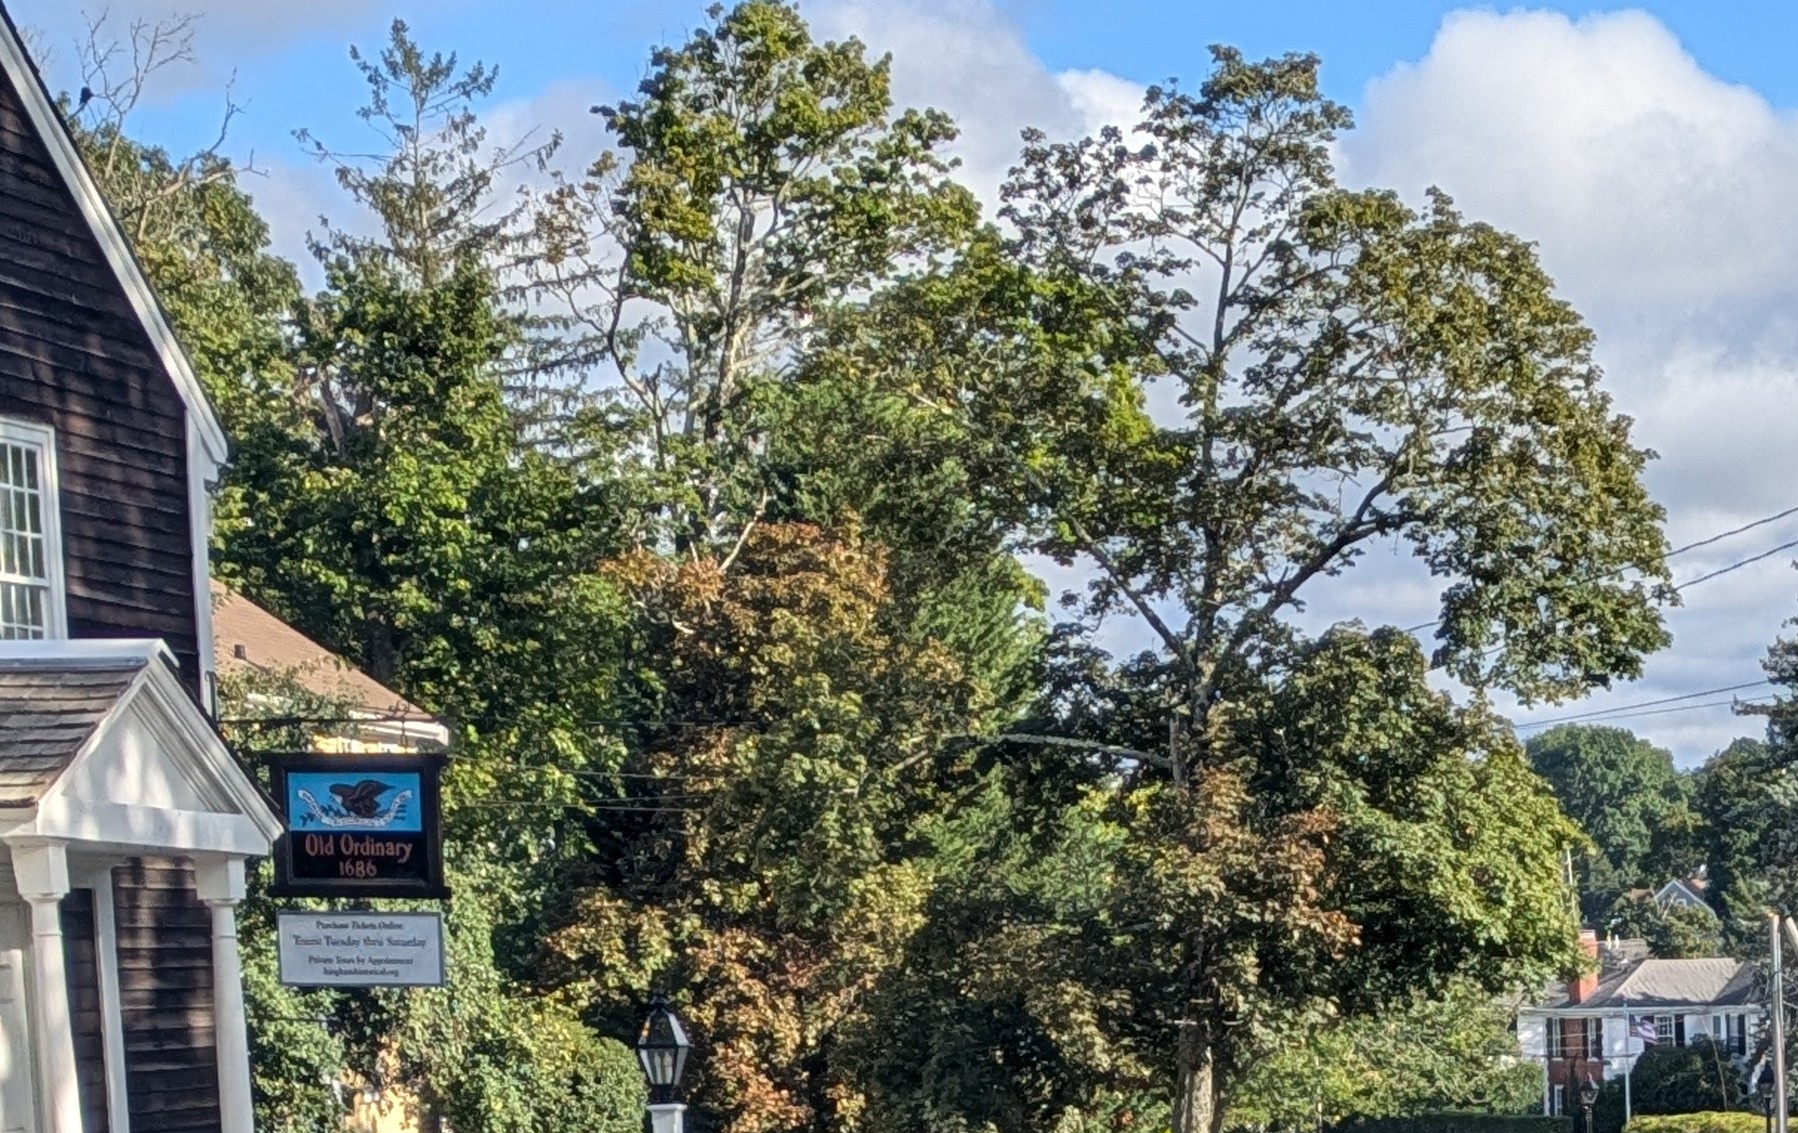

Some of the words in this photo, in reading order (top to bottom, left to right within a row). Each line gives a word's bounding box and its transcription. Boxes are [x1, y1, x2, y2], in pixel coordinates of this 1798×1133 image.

[305, 834, 335, 857] Old
[340, 834, 413, 864] Ordinary
[338, 859, 377, 879] 1686
[323, 935, 360, 948] Tuesday
[386, 936, 427, 949] Saturday
